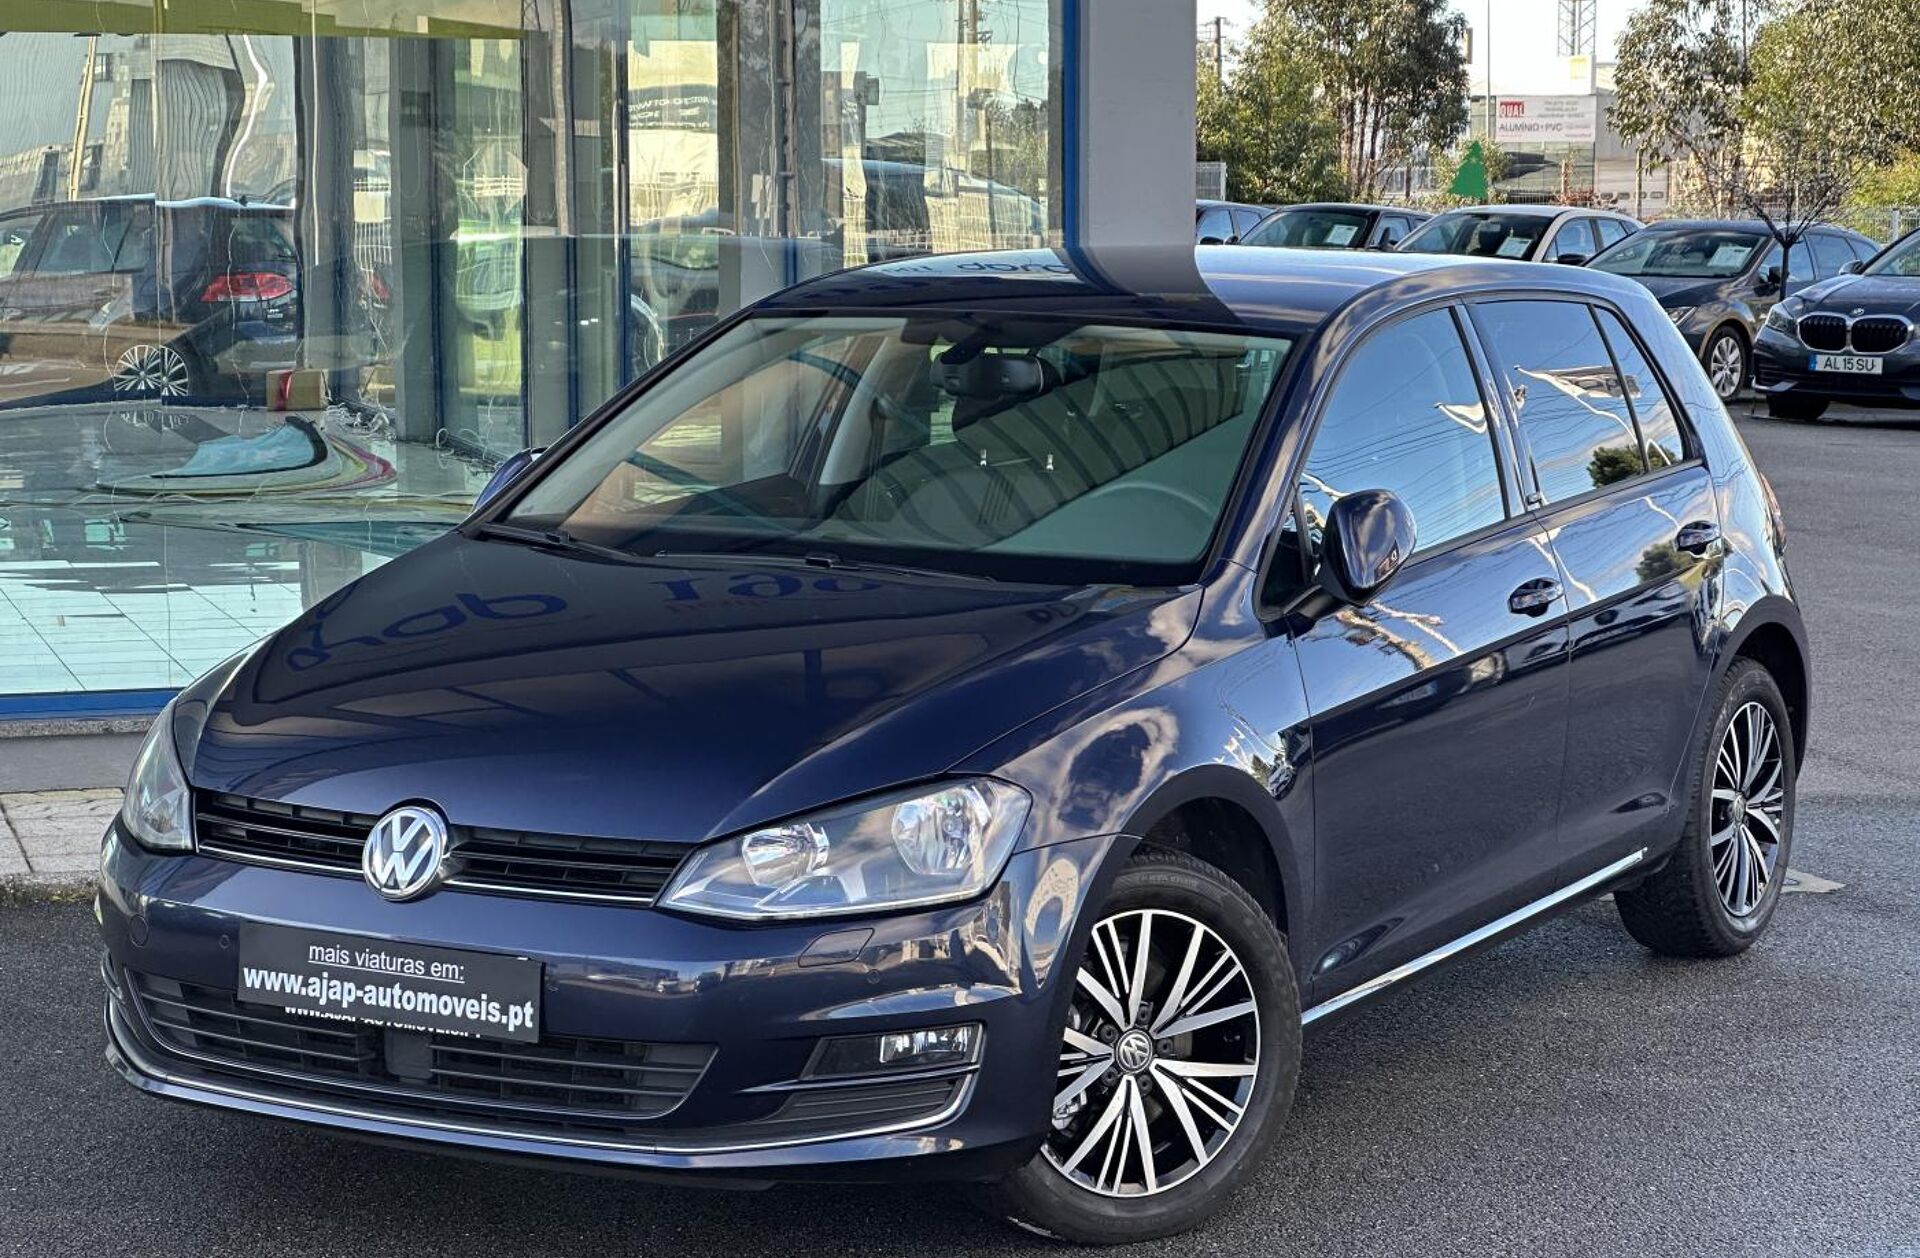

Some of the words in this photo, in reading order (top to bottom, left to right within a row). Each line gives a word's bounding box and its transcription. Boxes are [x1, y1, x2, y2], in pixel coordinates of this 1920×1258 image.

[1824, 356, 1840, 370] AL
[1843, 357, 1854, 371] 15
[1856, 358, 1874, 371] SU
[308, 943, 350, 965] mais
[354, 948, 426, 975] viaturas
[430, 960, 465, 981] em:
[242, 966, 535, 1031] www.ajap-automoveis.pt
